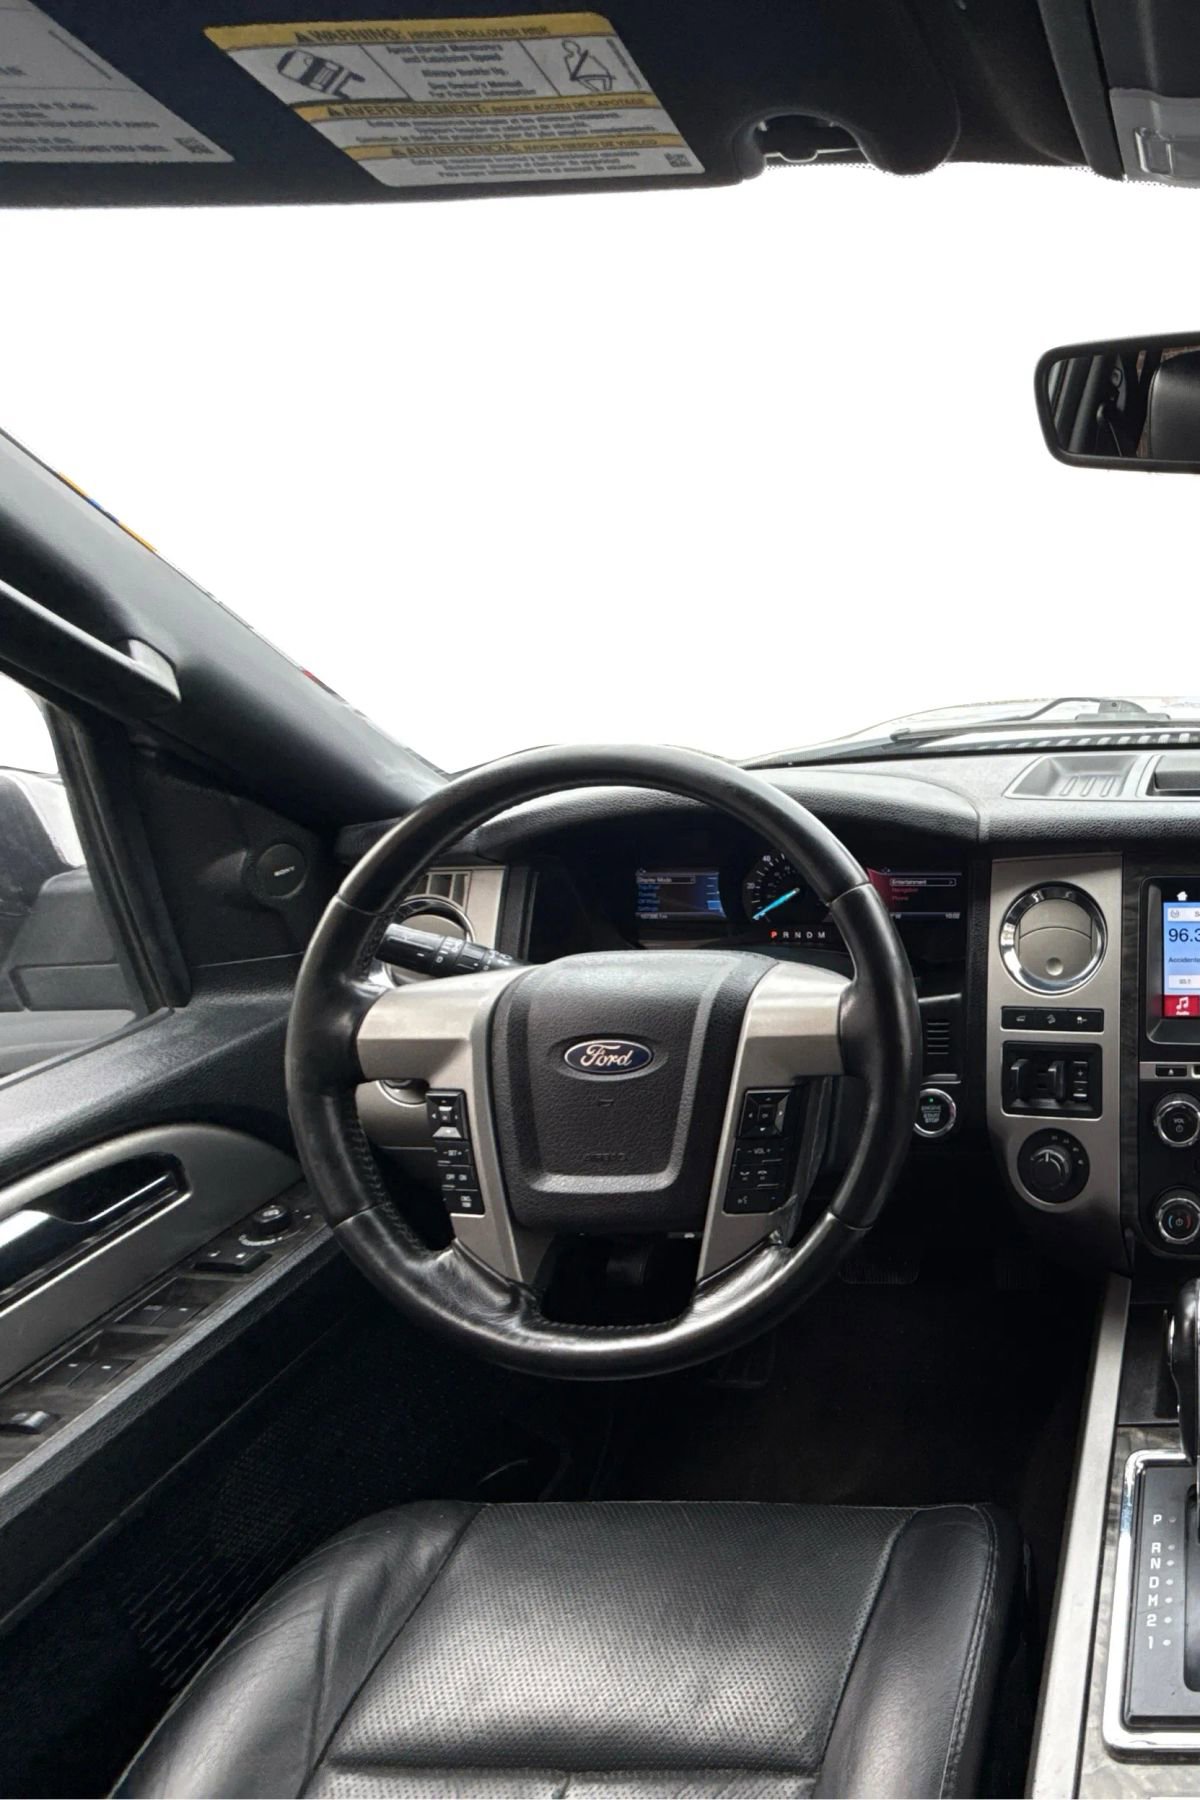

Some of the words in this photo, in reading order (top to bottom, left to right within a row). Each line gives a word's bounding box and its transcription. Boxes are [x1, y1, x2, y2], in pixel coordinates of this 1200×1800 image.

[580, 1044, 633, 1068] Ford
[1153, 1514, 1162, 1526] P
[1151, 1542, 1161, 1554] R
[1150, 1558, 1161, 1570] N
[1149, 1576, 1160, 1588] D
[1148, 1595, 1159, 1607] M
[1146, 1614, 1157, 1627] 2
[1148, 1637, 1154, 1649] 1
